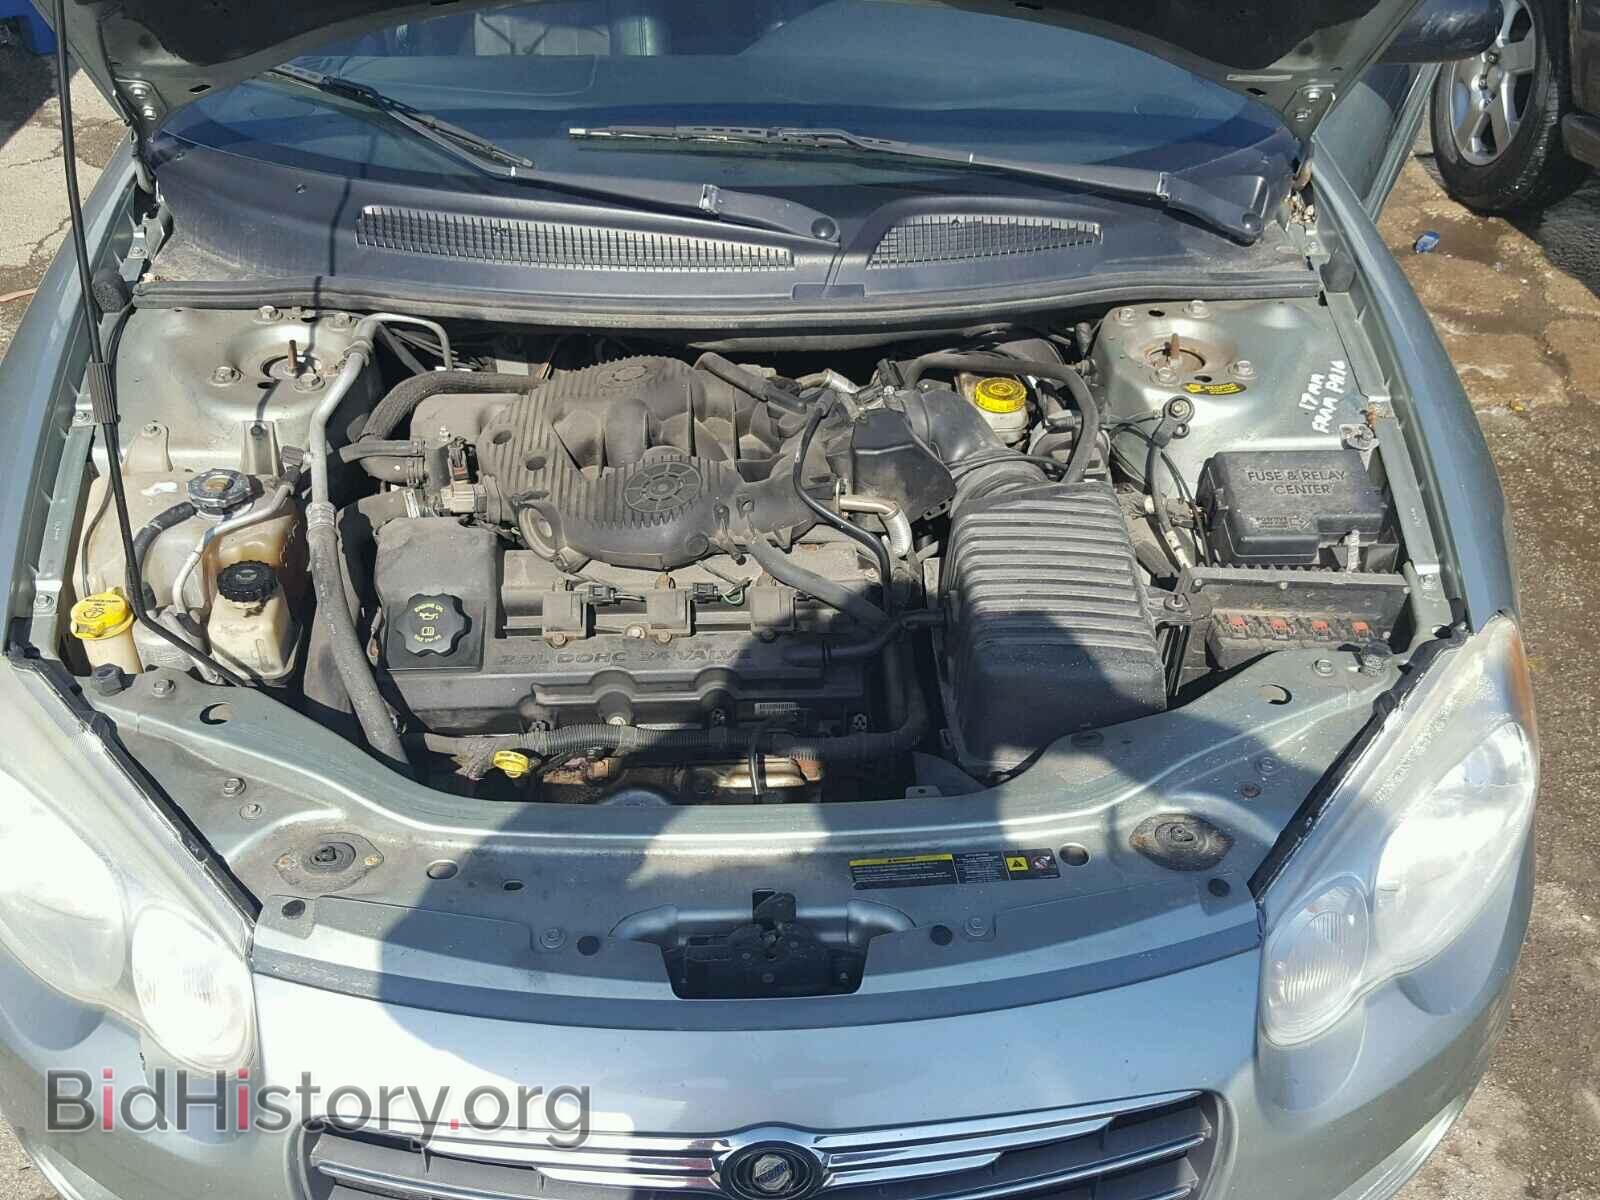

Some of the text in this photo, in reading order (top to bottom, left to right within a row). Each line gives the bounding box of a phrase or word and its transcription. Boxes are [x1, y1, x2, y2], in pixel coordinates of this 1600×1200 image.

[1247, 470, 1345, 481] FUSE & RELAY
[1273, 484, 1331, 495] CENTER
[556, 651, 626, 664] DOHC
